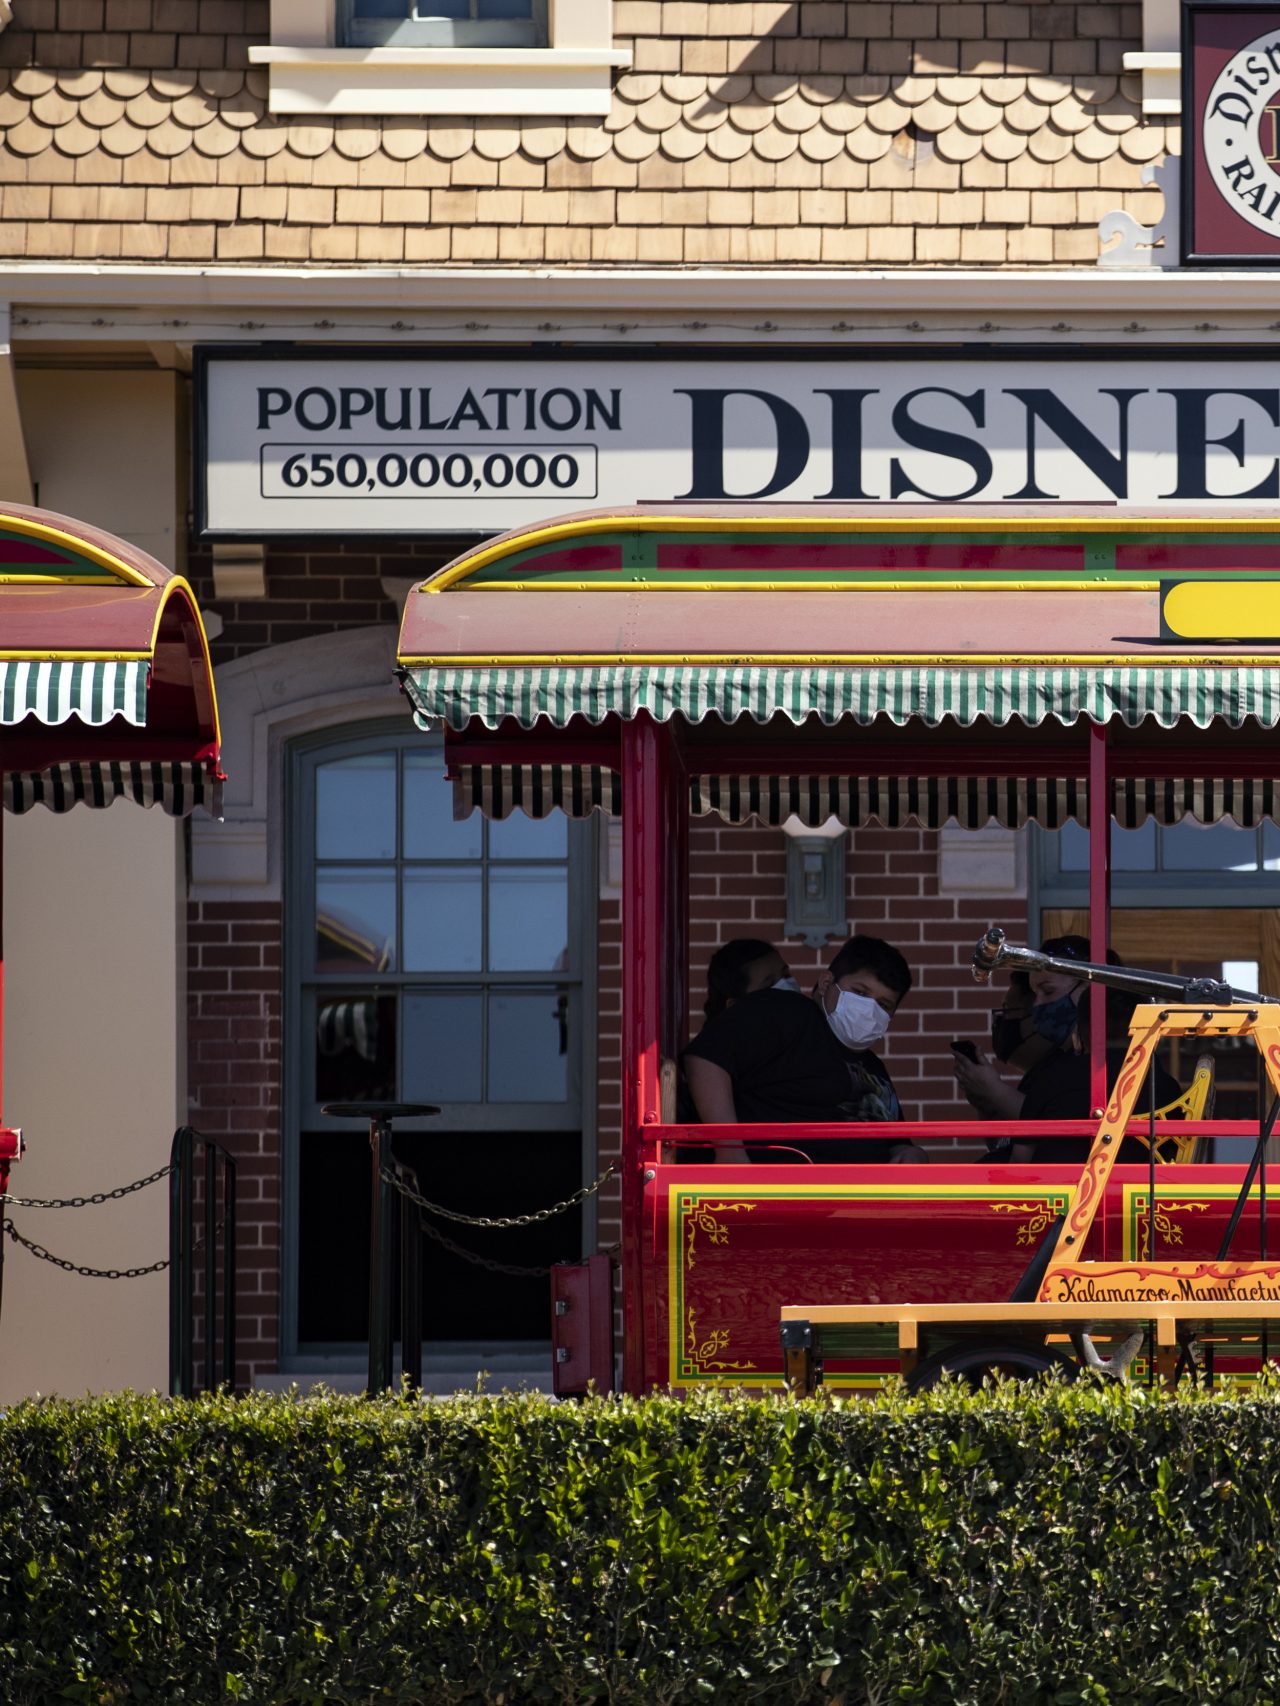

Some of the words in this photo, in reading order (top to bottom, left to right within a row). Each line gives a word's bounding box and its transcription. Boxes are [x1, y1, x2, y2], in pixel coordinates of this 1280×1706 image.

[255, 386, 623, 432] POPULATION
[280, 452, 579, 492] 650,000,000
[1058, 1277, 1171, 1301] Kalamazoo
